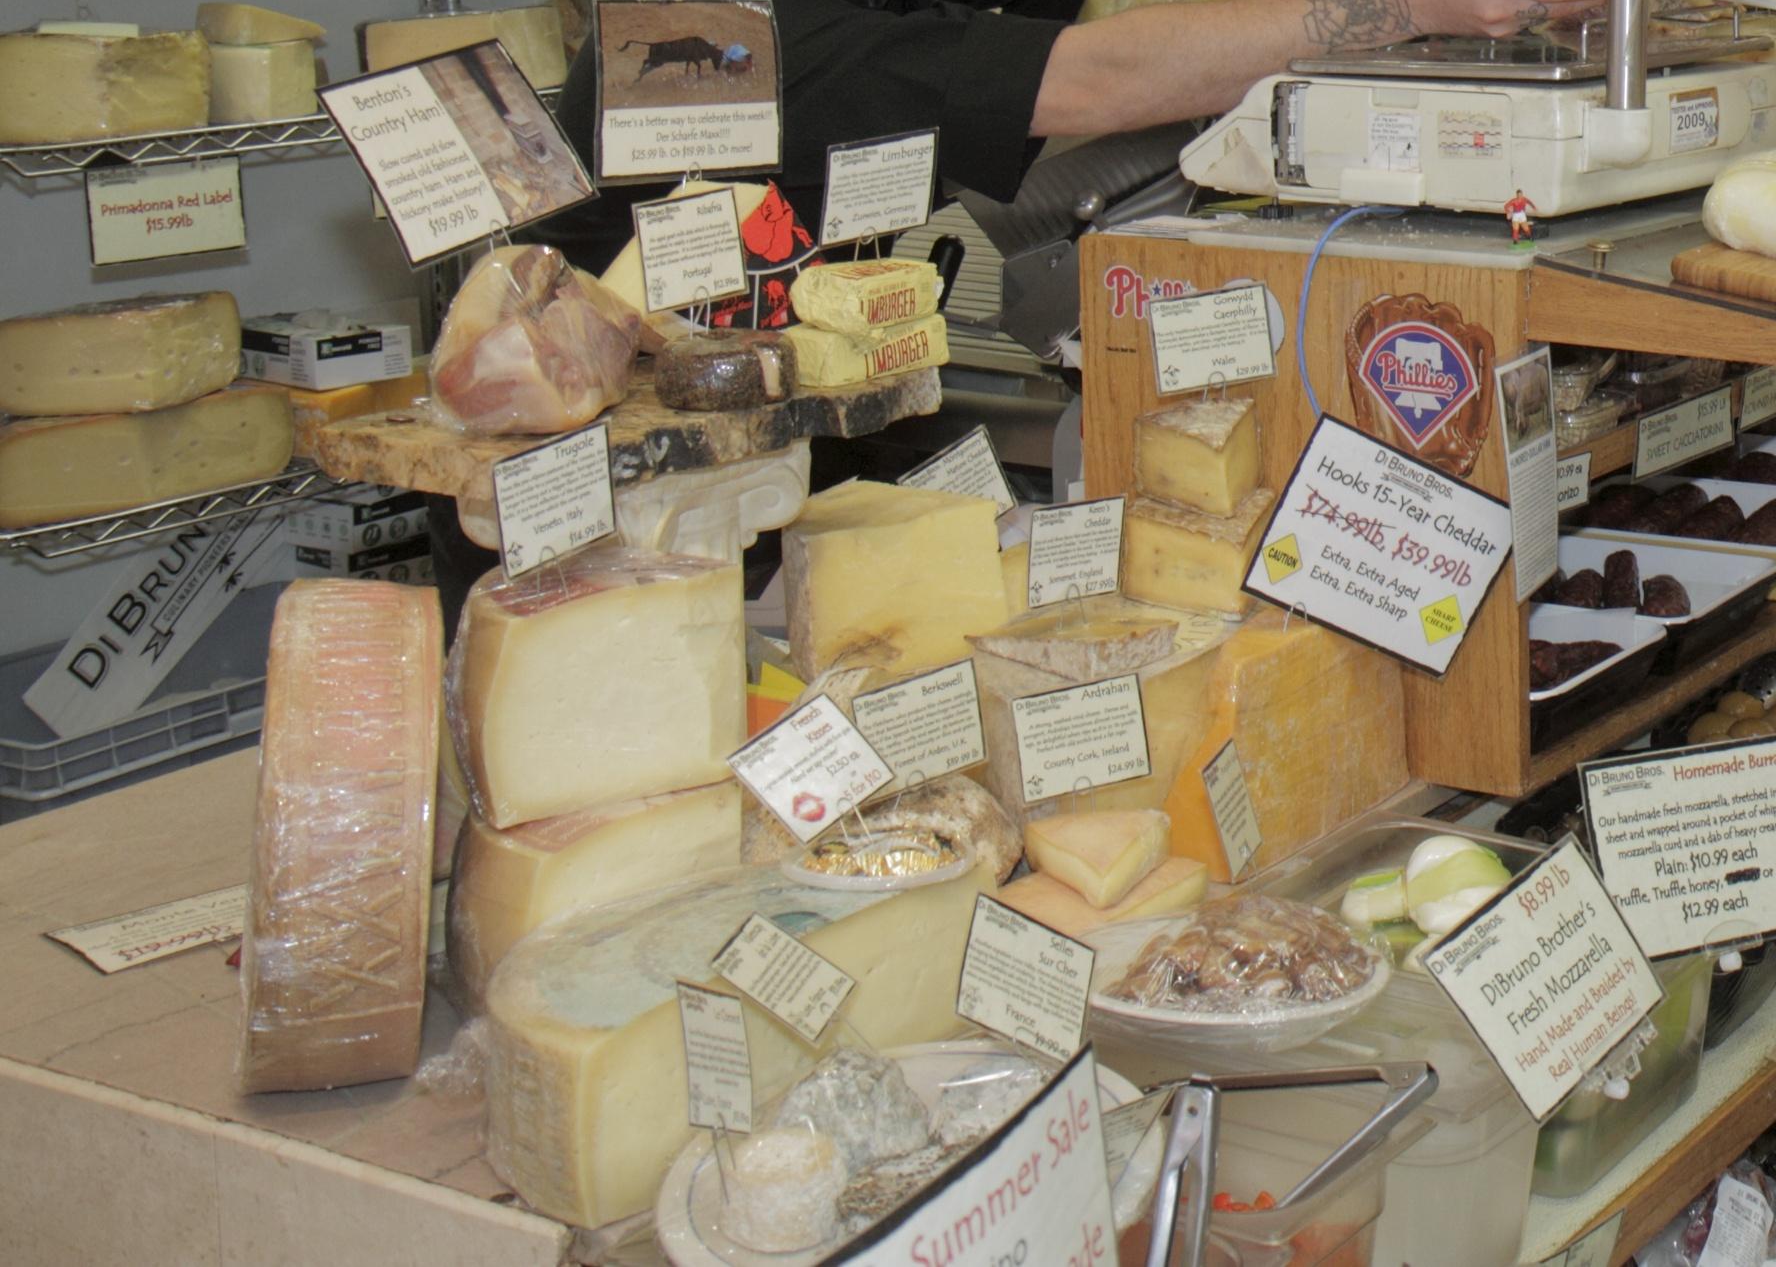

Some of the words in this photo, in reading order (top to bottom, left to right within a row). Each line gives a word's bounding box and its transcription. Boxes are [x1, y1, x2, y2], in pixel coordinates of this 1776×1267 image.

[352, 84, 412, 112] Benton's
[349, 113, 408, 142] Country
[410, 100, 446, 126] Ham!
[1677, 113, 1706, 131] 2009
[881, 144, 934, 163] Limburger
[101, 199, 174, 216] Primadonna
[177, 192, 200, 207] Red
[203, 187, 233, 205] Label
[146, 213, 193, 234] $15.99lb
[429, 212, 465, 236] $19.99
[466, 204, 479, 220] lb
[682, 264, 713, 279] Portugal
[1213, 291, 1254, 305] Gorwydd
[1213, 306, 1257, 320] Caerphilly
[865, 330, 929, 379] LIMBURGER
[1211, 355, 1236, 367] Wales
[1376, 351, 1459, 392] Phillies
[553, 432, 594, 459] Trugole
[1646, 444, 1671, 462] SWEET
[1672, 422, 1725, 454] CACCIATORINI
[1316, 455, 1370, 496] Hooks
[1372, 485, 1432, 525] 15-Year
[1433, 514, 1497, 558] Cheddar
[1084, 517, 1111, 529] Cheddar
[1267, 545, 1299, 571] CAUTION
[1390, 531, 1473, 589] $39.99lb
[1320, 545, 1354, 572] Extra,
[1355, 561, 1386, 588] Extra
[1386, 577, 1421, 602] Aged
[1309, 564, 1341, 592] Extra,
[1344, 581, 1375, 608] Extra
[1375, 596, 1409, 621] Sharp
[1424, 612, 1453, 633] CHEESE
[1430, 605, 1457, 623] SHARP
[921, 672, 964, 696] Berkswell
[1080, 682, 1130, 701] Ardrahan
[790, 707, 823, 731] French
[805, 721, 834, 744] Kisses
[1044, 756, 1075, 770] County
[1077, 752, 1100, 762] Cork,
[1102, 742, 1130, 757] Ireland
[1673, 756, 1746, 782] Homemade
[1599, 815, 1616, 828] Our
[1617, 806, 1661, 824] handmade
[1662, 803, 1683, 817] fresh
[1685, 795, 1729, 814] mozzarella,
[1731, 791, 1768, 805] stretched
[1655, 856, 1689, 877] Plain:
[1689, 848, 1728, 873] $10.99
[1731, 841, 1758, 863] each
[1517, 876, 1555, 921] $8.99
[1554, 863, 1571, 888] lb
[1682, 898, 1720, 923] $12.99
[1723, 891, 1749, 912] each
[1049, 936, 1074, 958] Selles
[1480, 951, 1543, 1007] DiBruno
[1536, 900, 1597, 957] Brother's
[1506, 989, 1550, 1035] Fresh
[1549, 934, 1614, 998] Mozzarella
[1006, 1004, 1037, 1027] France
[909, 1147, 1043, 1267] Summer
[1046, 1089, 1092, 1170] Sale
